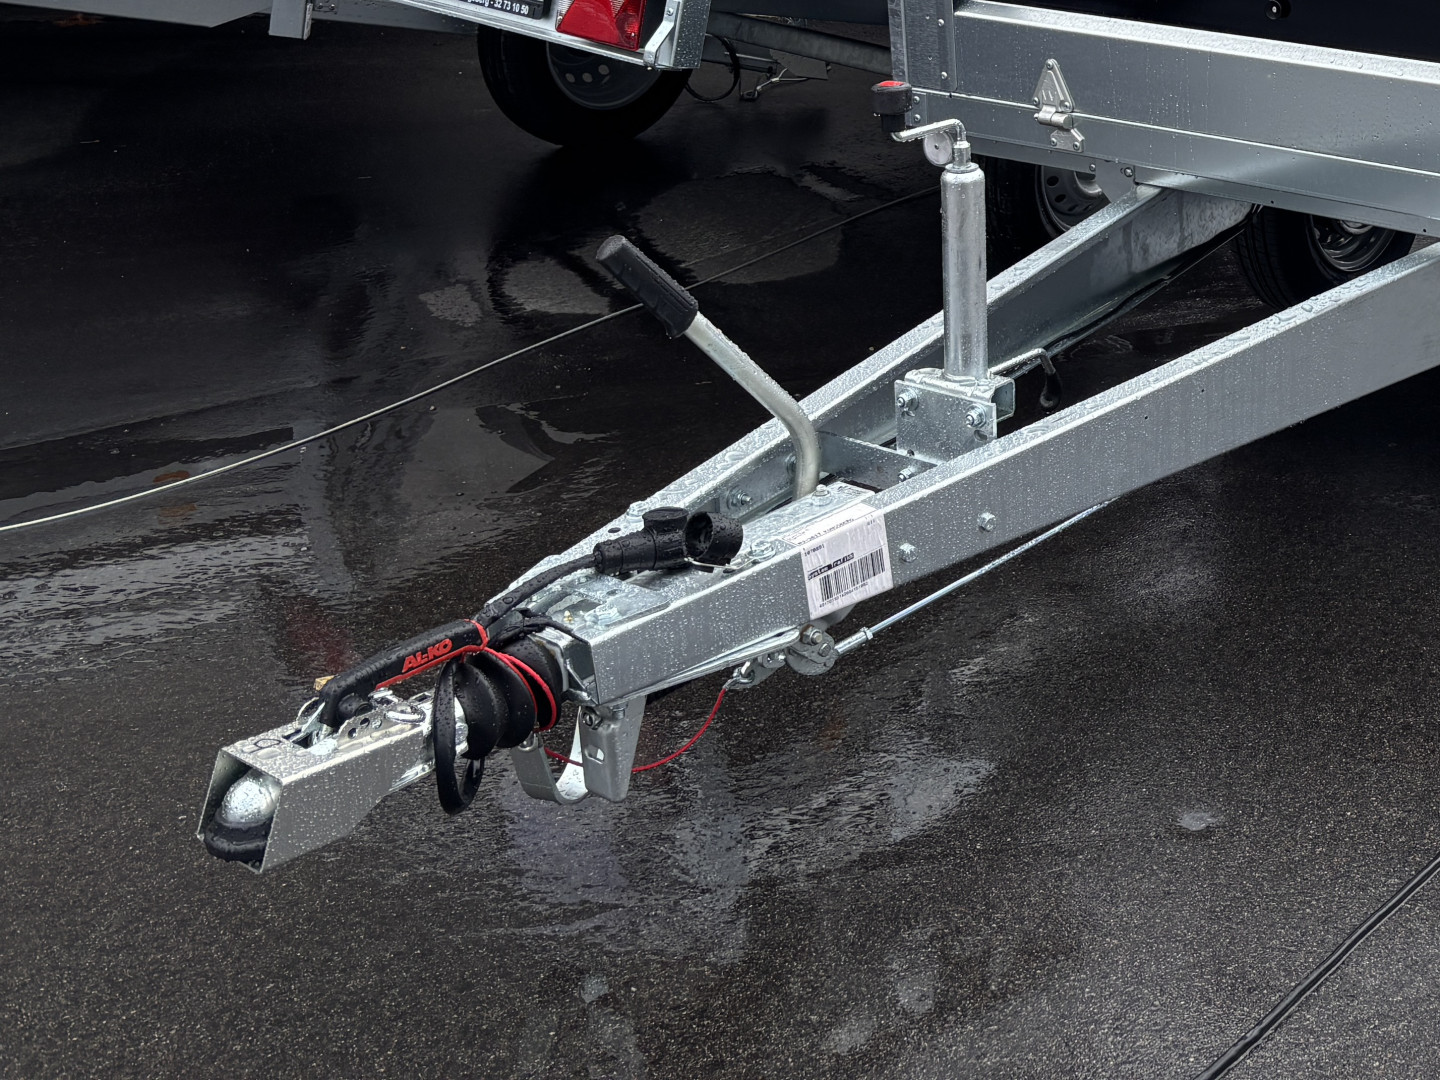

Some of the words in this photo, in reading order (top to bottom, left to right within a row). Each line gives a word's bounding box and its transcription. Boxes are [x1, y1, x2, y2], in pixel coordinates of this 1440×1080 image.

[503, 0, 511, 11] 73
[512, 2, 520, 13] 10
[520, 3, 529, 15] 50
[402, 638, 453, 673] AL-KO
